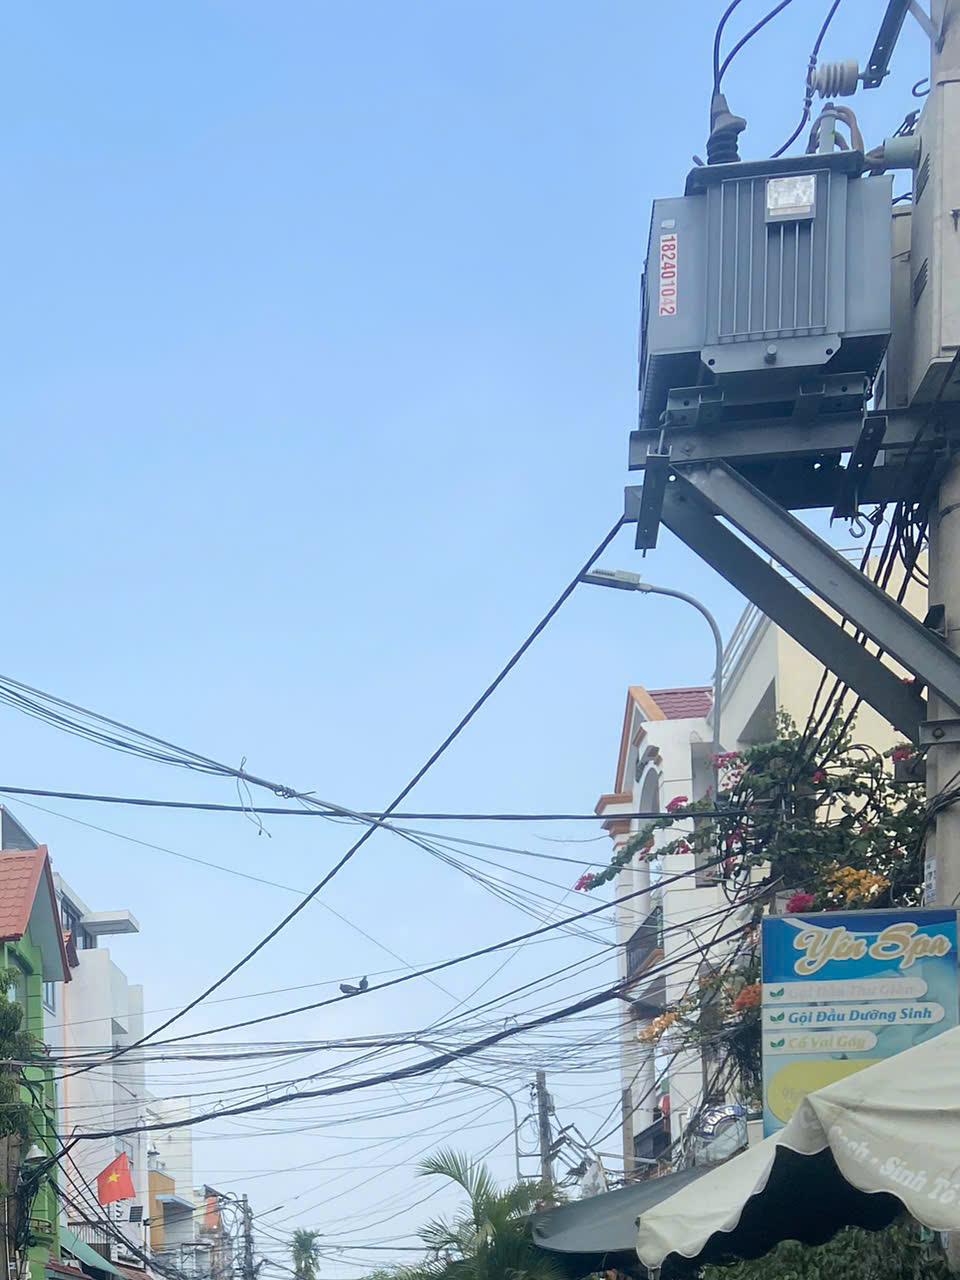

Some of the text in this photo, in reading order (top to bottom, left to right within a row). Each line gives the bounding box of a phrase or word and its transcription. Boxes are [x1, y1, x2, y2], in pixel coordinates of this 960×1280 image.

[661, 235, 676, 315] 182401042
[869, 922, 953, 969] Spa
[788, 1007, 932, 1026] Gội Đầu Dưỡng Sinh
[879, 1155, 928, 1193] Sinh
